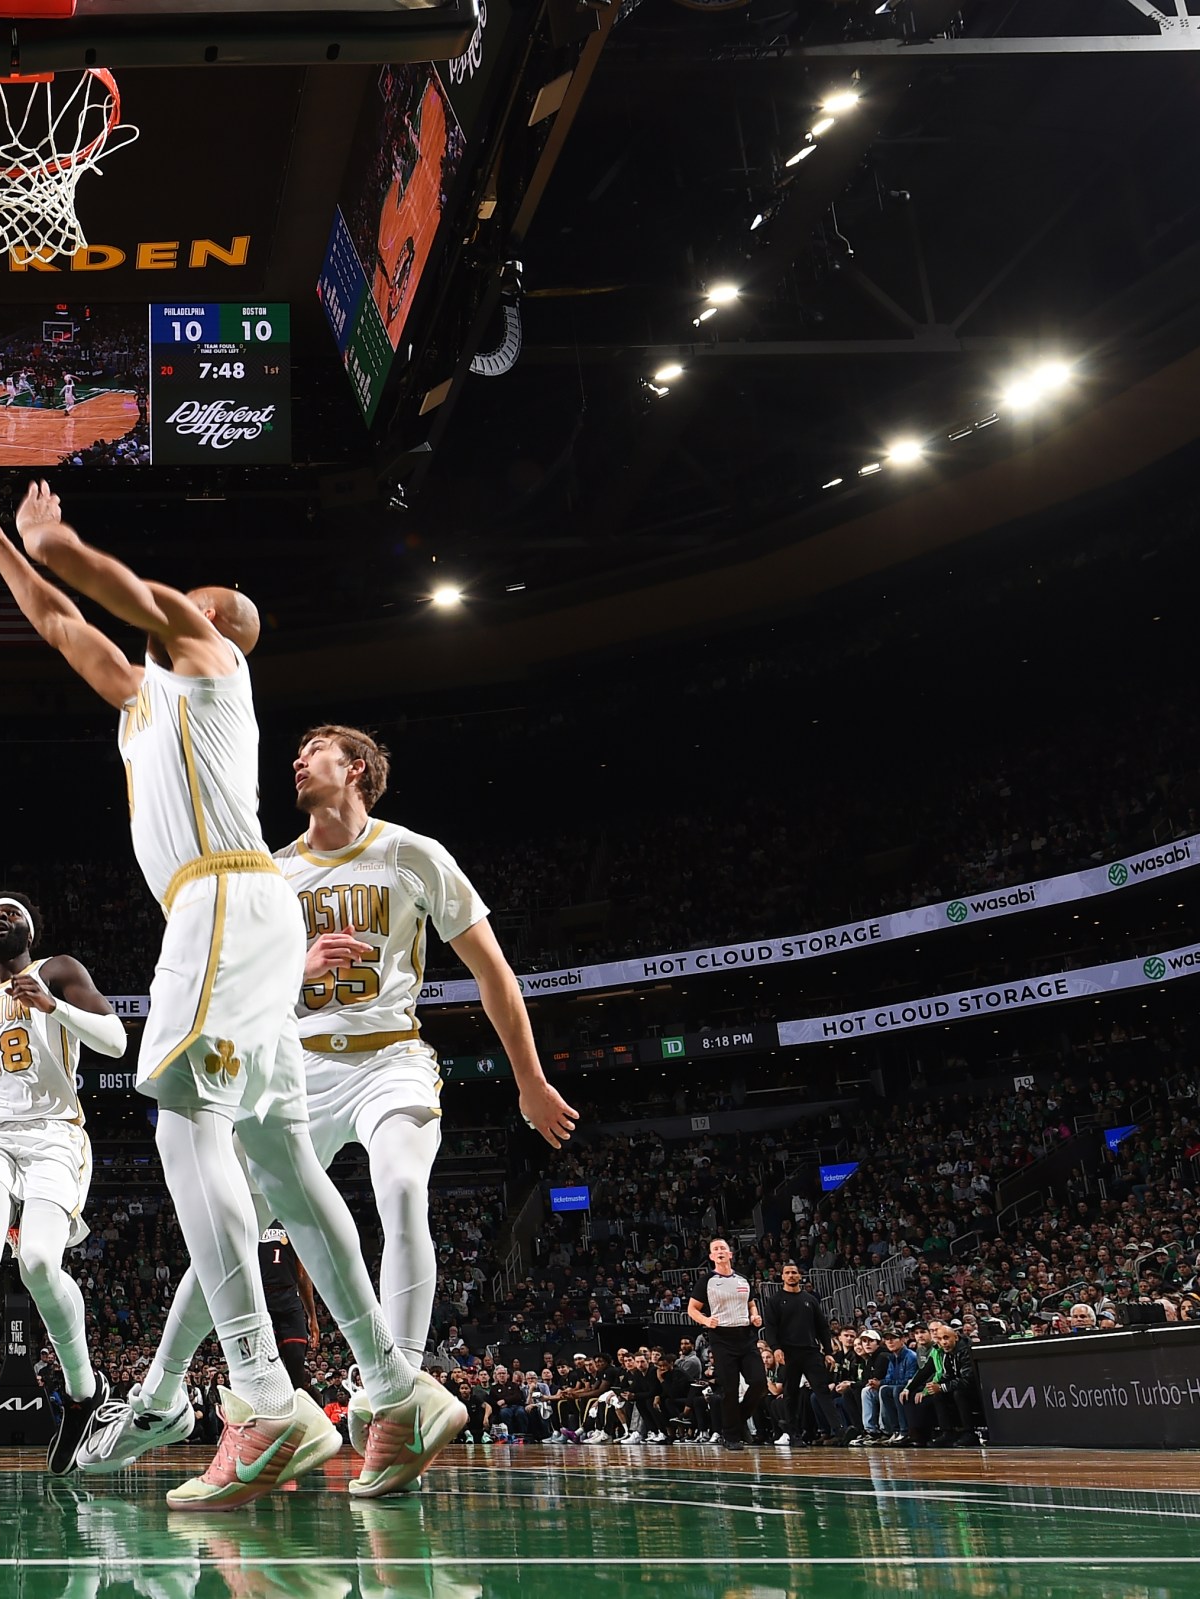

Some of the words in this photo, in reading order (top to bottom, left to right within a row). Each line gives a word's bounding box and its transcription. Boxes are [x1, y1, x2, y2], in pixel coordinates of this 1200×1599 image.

[164, 308, 205, 316] PHILADELPHIA
[242, 307, 267, 316] BOSTON
[172, 321, 202, 341] 10
[242, 320, 272, 341] 10
[161, 366, 174, 375] 20
[199, 361, 245, 379] 7:48
[264, 366, 279, 375] 1st
[165, 400, 276, 434] Different
[197, 421, 263, 450] Here
[1130, 845, 1191, 876] wasabi
[300, 884, 390, 936] OSTON
[970, 886, 1035, 914] wasabi
[643, 957, 687, 977] HOT
[696, 946, 773, 968] CLOUD
[782, 924, 881, 957] STORAGE
[527, 970, 581, 991] wasabi
[823, 1016, 866, 1037] HOT
[875, 1001, 950, 1028] CLOUD
[958, 978, 1069, 1013] STORAGE
[664, 1041, 682, 1053] TD
[702, 1036, 730, 1049] 8:18
[733, 1033, 753, 1046] PM
[446, 1068, 452, 1076] 7
[554, 1195, 586, 1203] ticketmaster
[273, 1249, 281, 1263] 1
[11, 1321, 23, 1332] GET
[11, 1332, 23, 1343] THE
[14, 1344, 27, 1356] App
[1043, 1385, 1066, 1408] Kia
[1069, 1383, 1128, 1408] Sorento
[1130, 1378, 1200, 1406] Turbo-H
